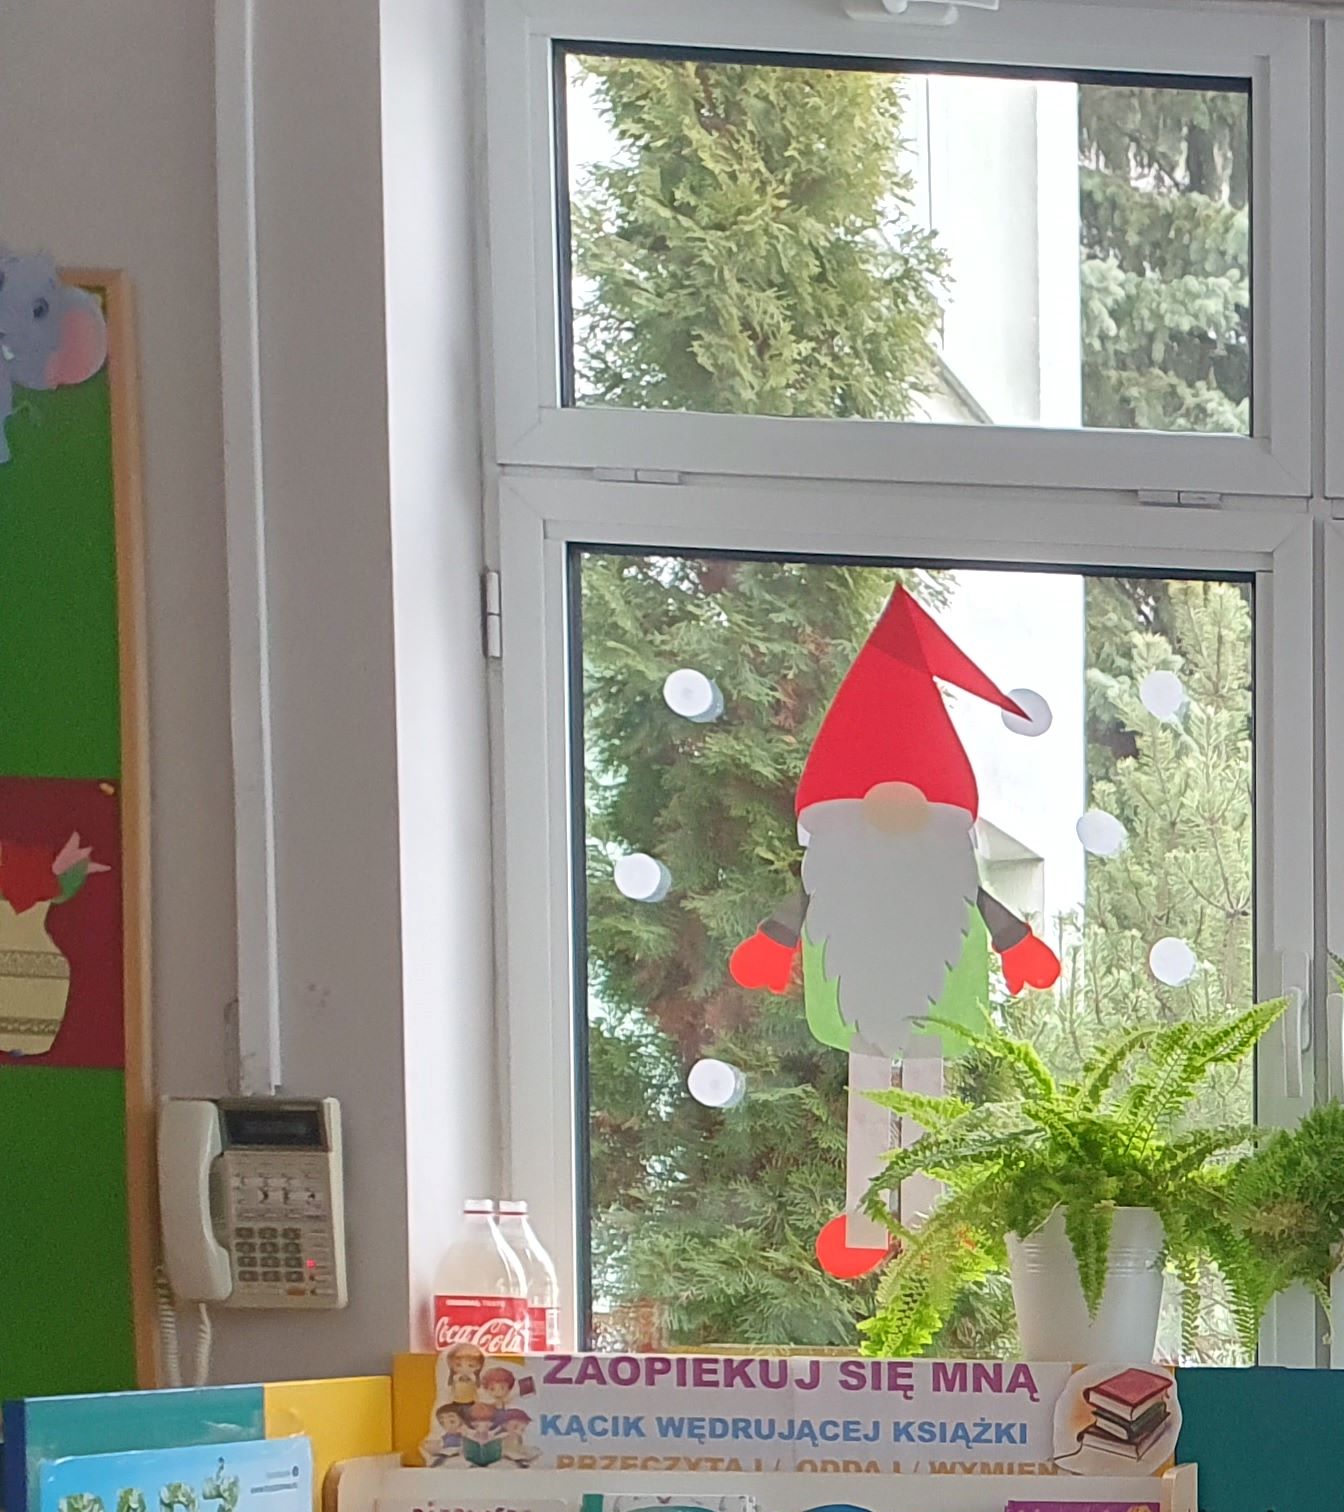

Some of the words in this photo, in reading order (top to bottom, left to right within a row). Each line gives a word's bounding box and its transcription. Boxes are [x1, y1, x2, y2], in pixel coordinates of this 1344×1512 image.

[543, 1354, 820, 1391] ZAOPIEKUJ
[838, 1360, 914, 1400] SIĘ
[932, 1362, 1040, 1402] MNĄ
[540, 1414, 646, 1442] KĄCIK
[656, 1416, 880, 1447] WĘDRUJĄCEJ
[893, 1417, 1028, 1449] KSIĄŻKI
